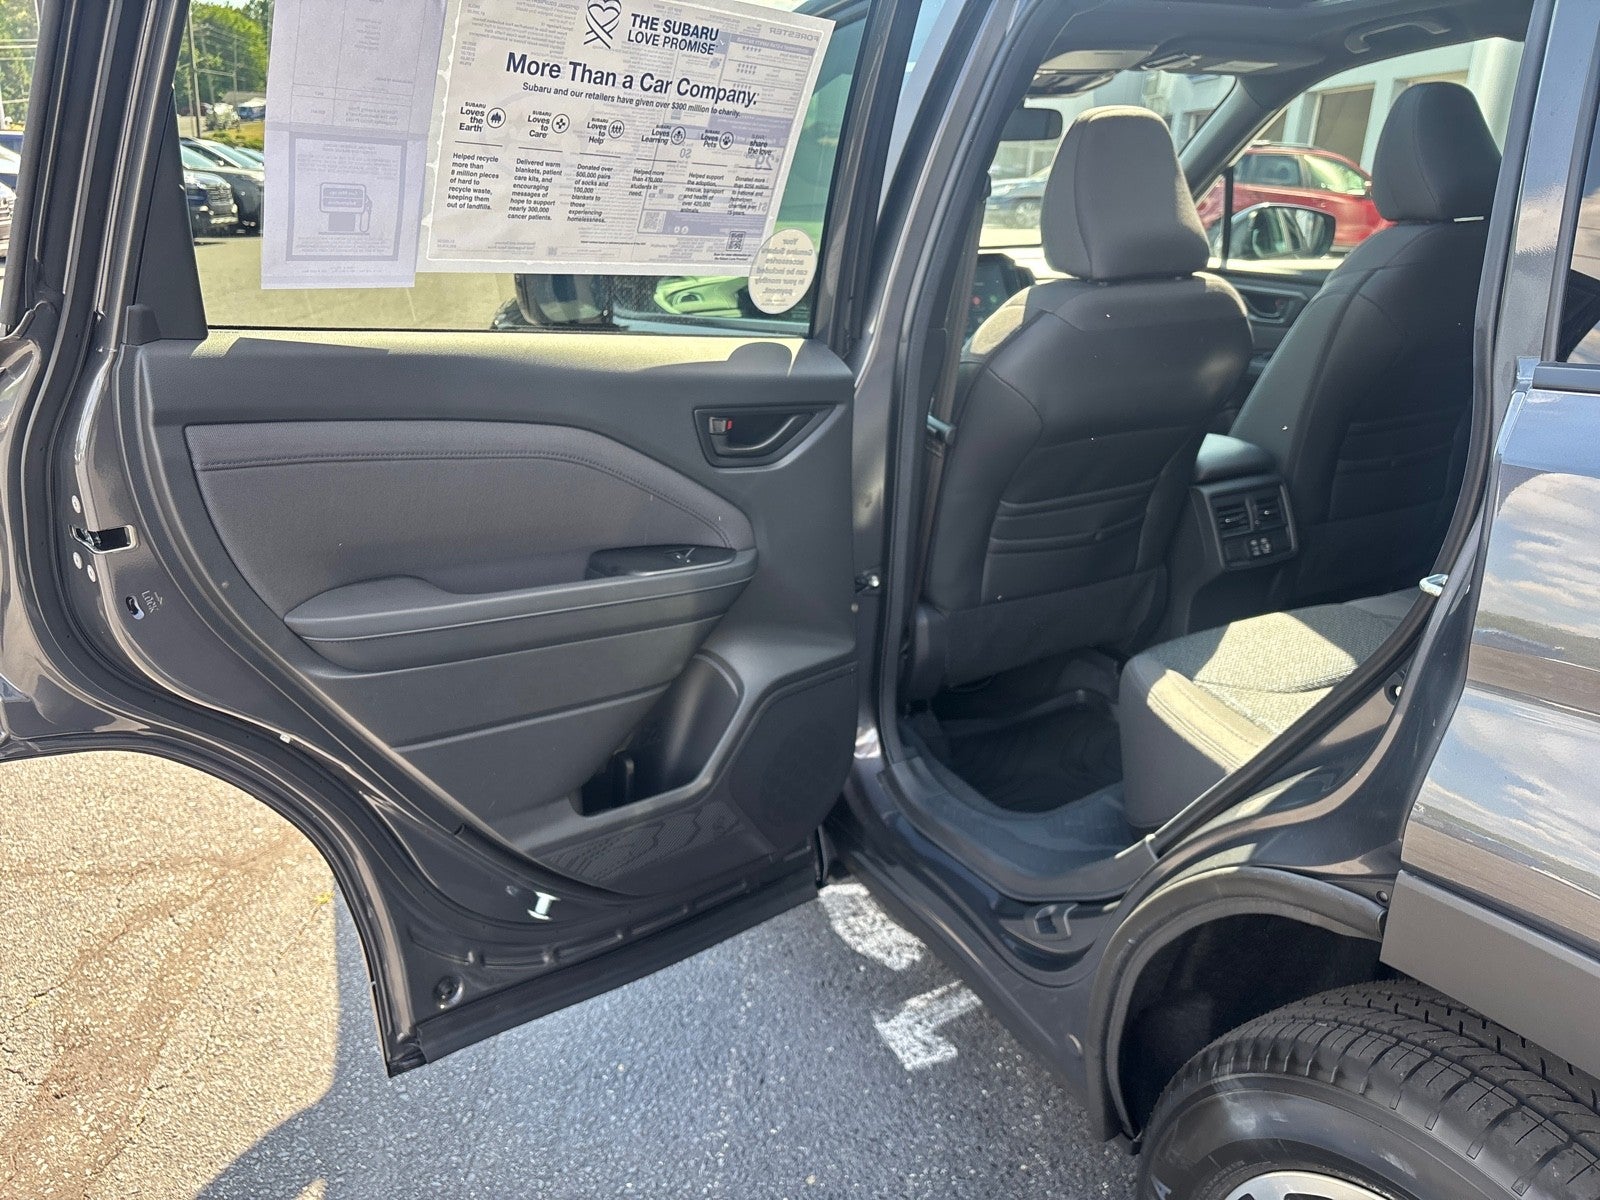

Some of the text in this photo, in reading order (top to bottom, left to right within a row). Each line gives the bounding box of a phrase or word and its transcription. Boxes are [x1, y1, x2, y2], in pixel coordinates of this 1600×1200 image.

[631, 13, 659, 31] THE
[662, 19, 719, 41] SUBARU
[627, 29, 660, 47] LOVE
[662, 37, 716, 55] PROMISE
[506, 51, 561, 79] More
[569, 61, 617, 87] Than
[622, 74, 634, 89] a
[639, 72, 673, 95] Car
[522, 82, 551, 93] Subaru
[553, 86, 569, 96] and
[570, 90, 583, 98] our
[585, 91, 615, 103] retailers
[616, 95, 633, 105] have
[635, 97, 654, 108] given
[655, 101, 671, 109] over
[671, 100, 687, 111] $300
[688, 103, 710, 113] million
[718, 107, 741, 118] charity.
[460, 107, 485, 116] Loves
[470, 116, 483, 124] the
[528, 115, 550, 124] Loves
[459, 123, 482, 132] Earth
[541, 124, 549, 132] to
[587, 122, 607, 131] Loves
[529, 130, 547, 139] Care
[588, 137, 604, 145] Help
[641, 135, 669, 145] Learning
[453, 153, 499, 163] Helped recycle
[516, 158, 544, 166] Delivered
[447, 193, 473, 202] keeping
